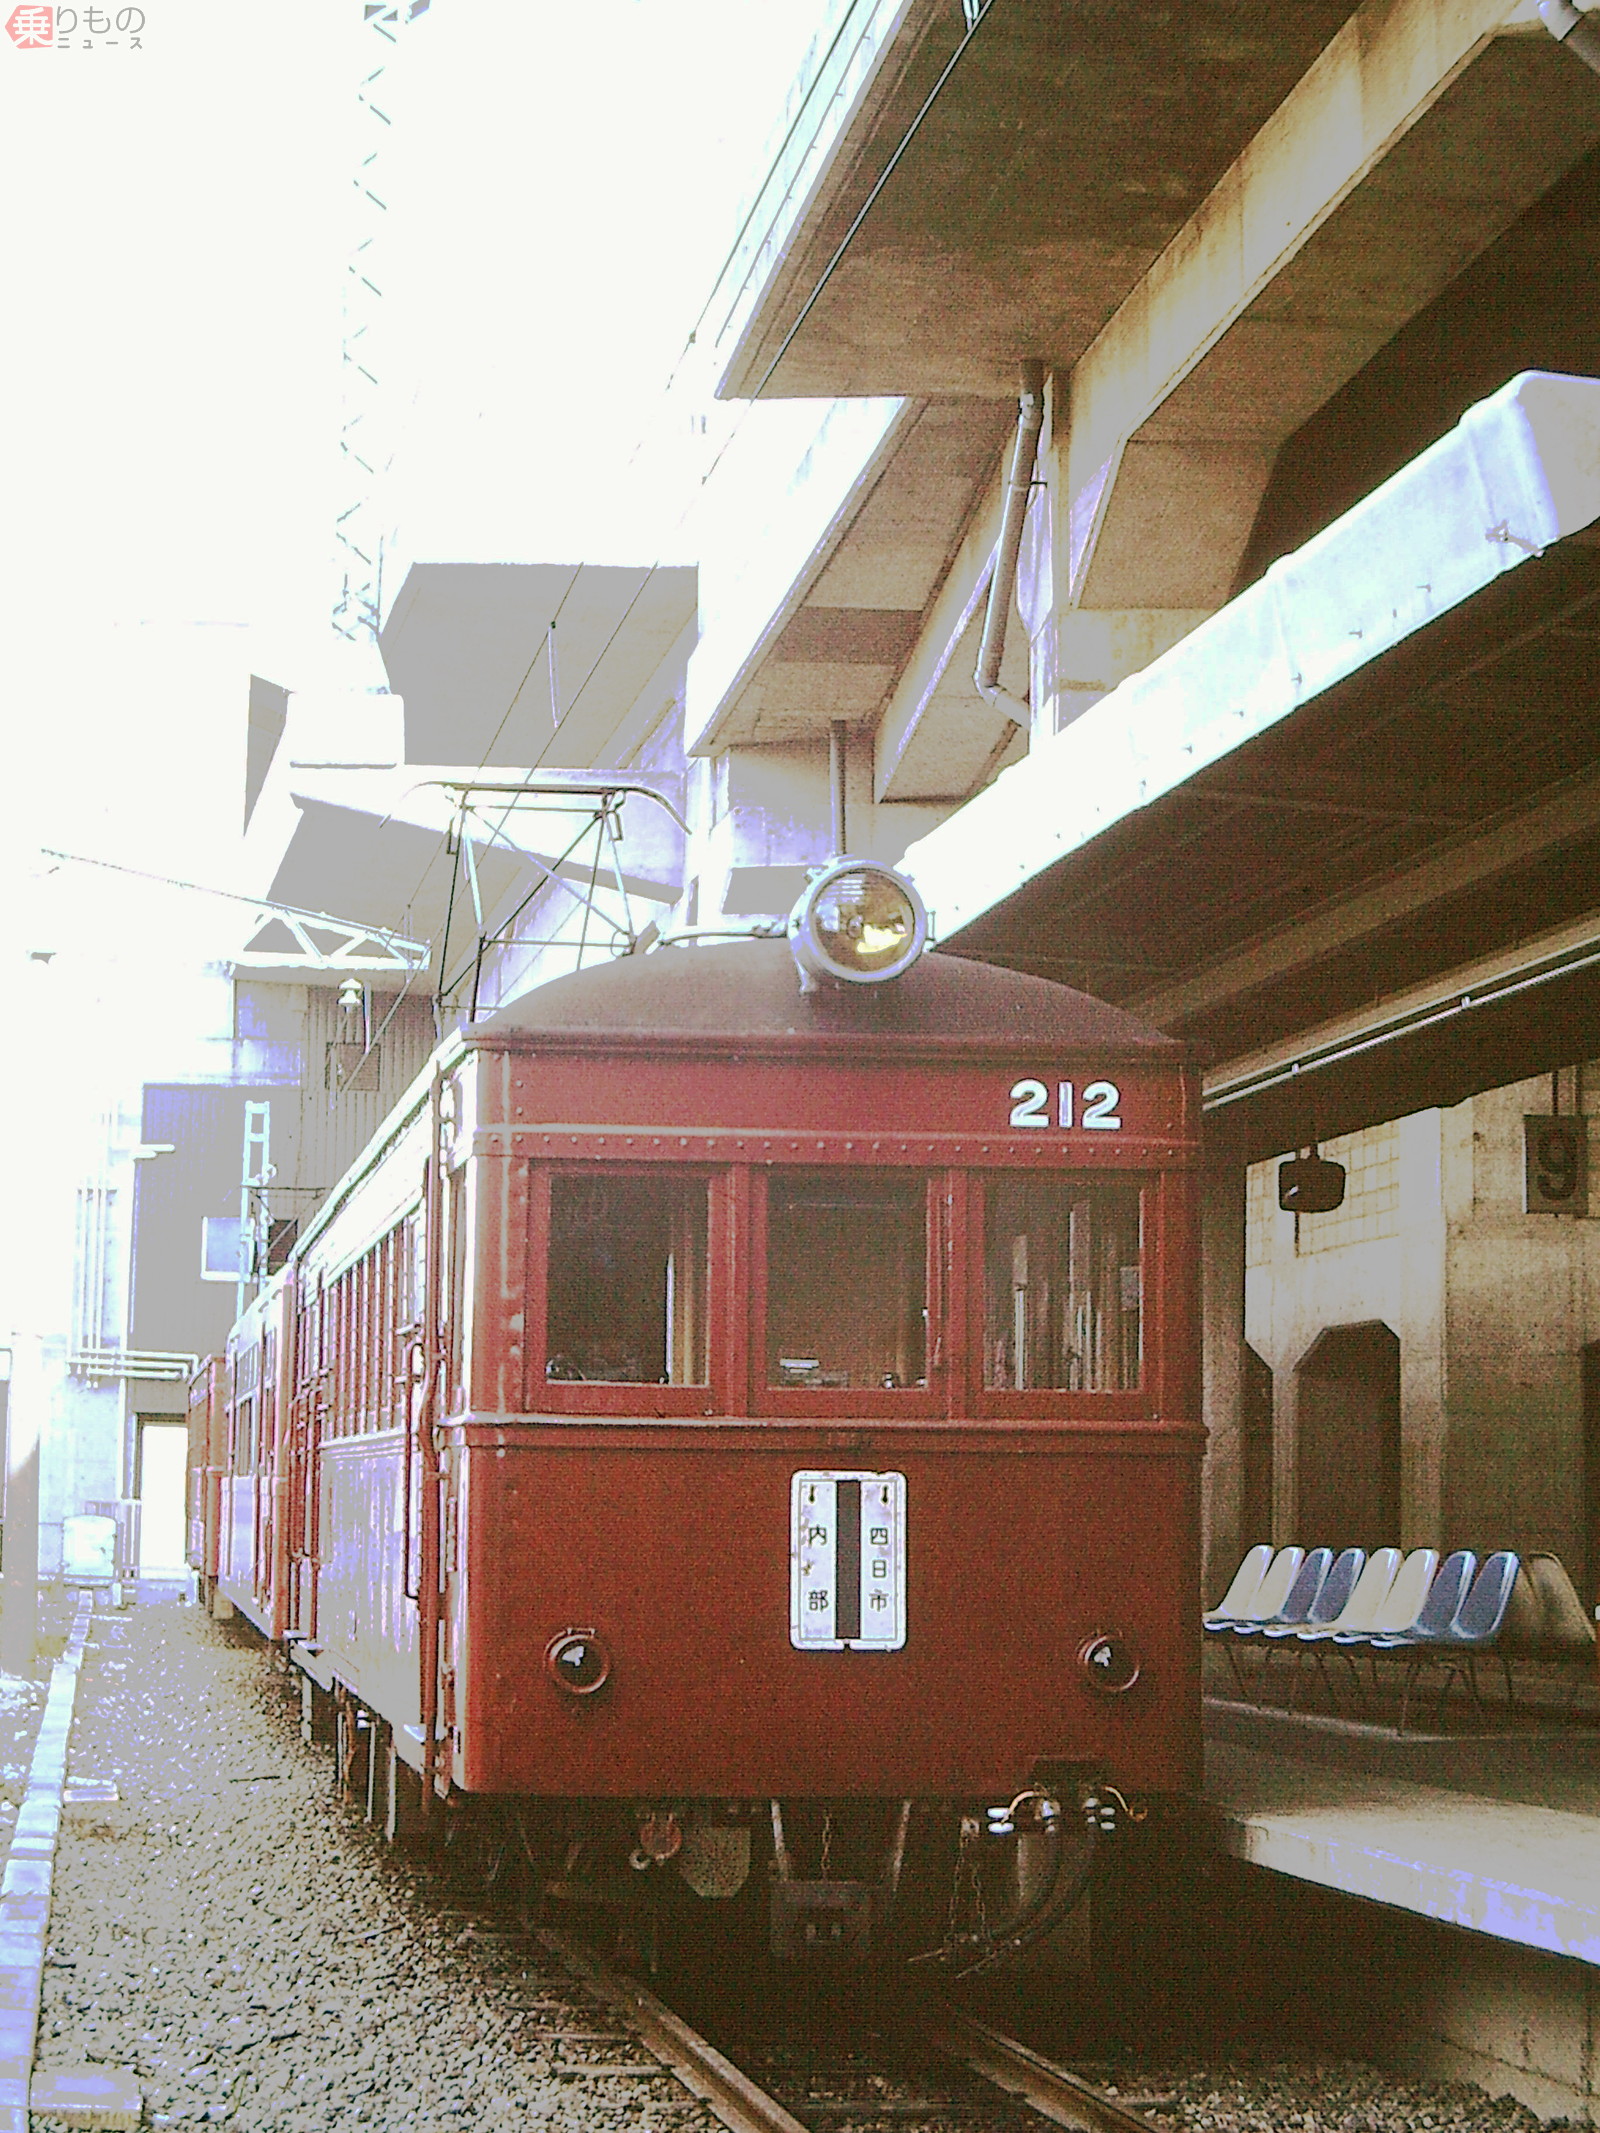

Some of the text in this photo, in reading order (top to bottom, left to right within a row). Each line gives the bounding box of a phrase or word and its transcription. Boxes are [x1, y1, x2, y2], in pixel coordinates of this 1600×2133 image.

[1009, 1078, 1122, 1130] 212
[1537, 1128, 1578, 1201] 9
[808, 1524, 829, 1613] 内部
[868, 1526, 890, 1613] 四日市
